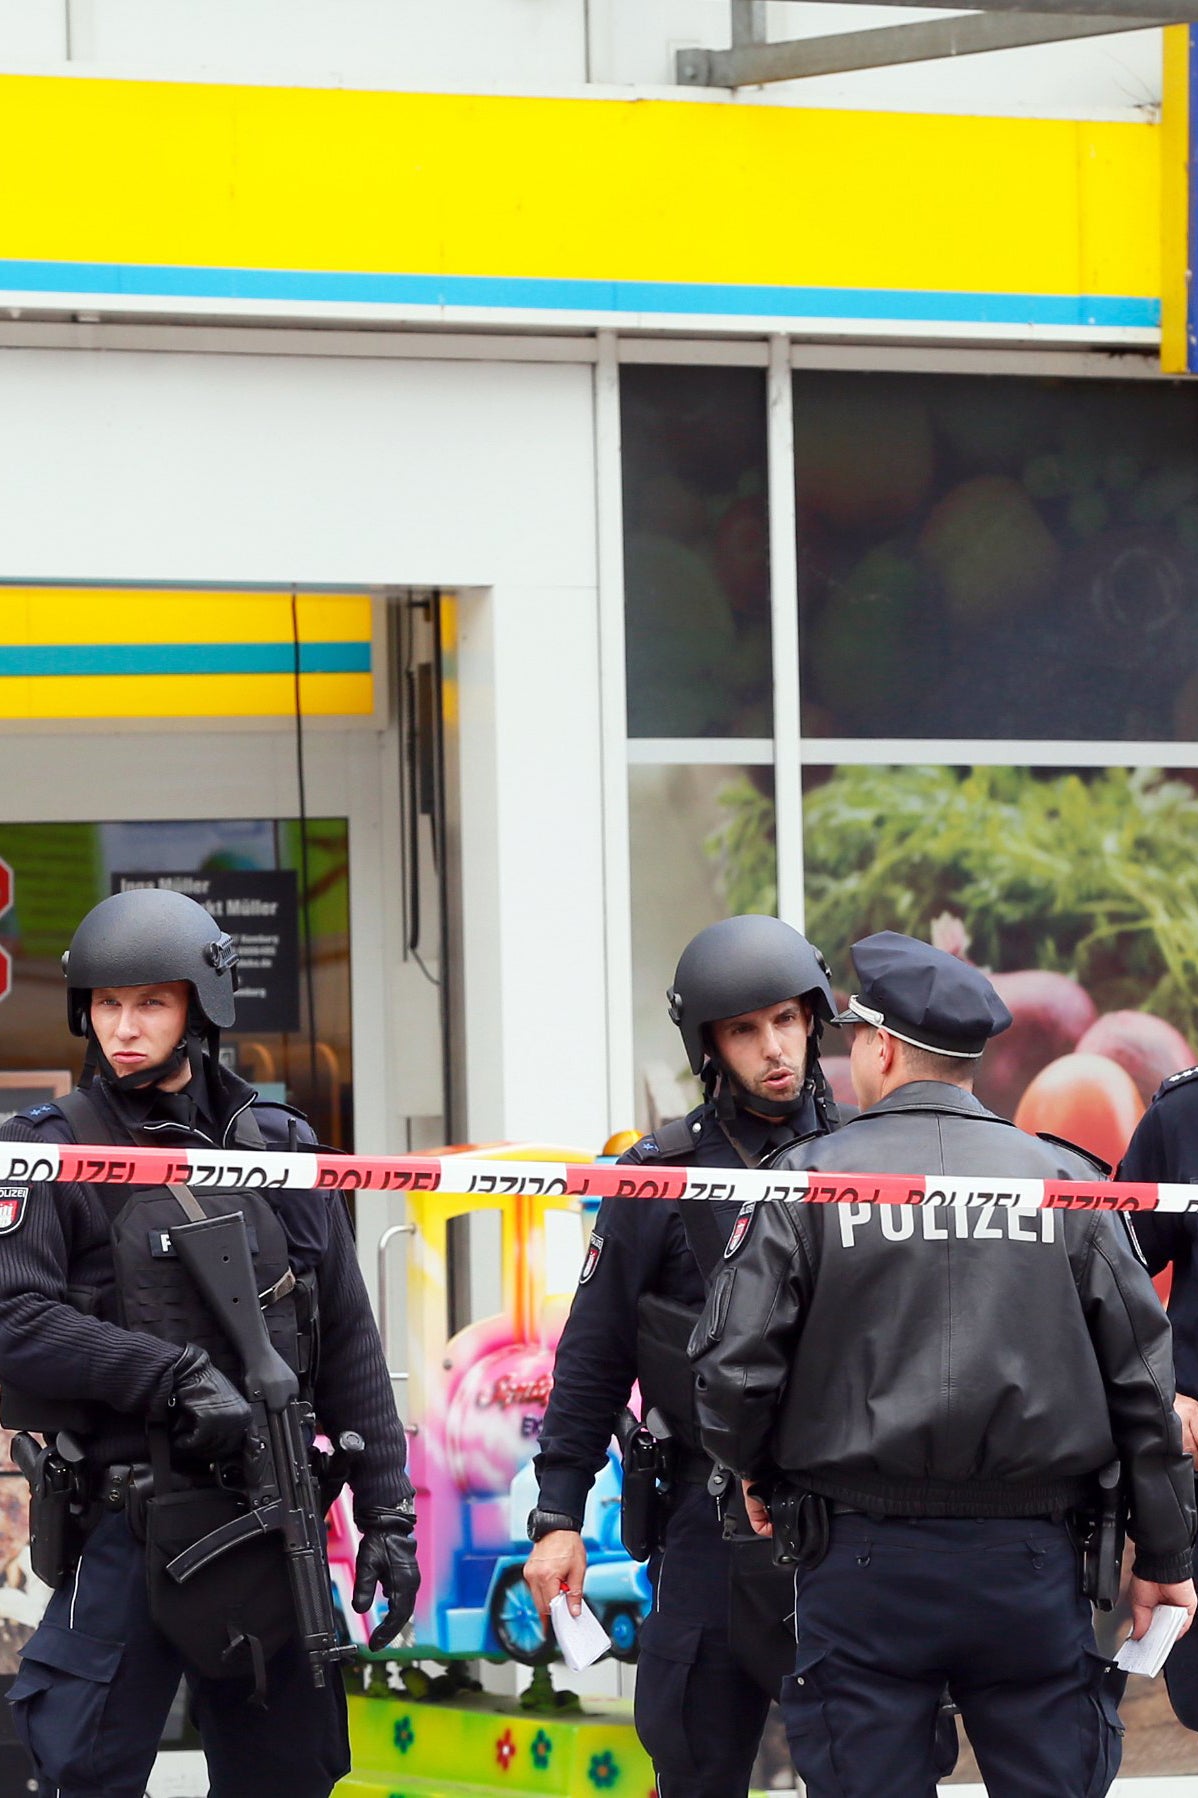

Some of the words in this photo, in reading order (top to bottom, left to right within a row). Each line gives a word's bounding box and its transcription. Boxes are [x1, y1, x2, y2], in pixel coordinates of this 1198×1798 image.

[226, 897, 279, 917] Müller
[9, 1158, 136, 1183] POLIZEI
[0, 1189, 26, 1198] OLIZEI
[838, 1202, 1056, 1248] POLIZEI
